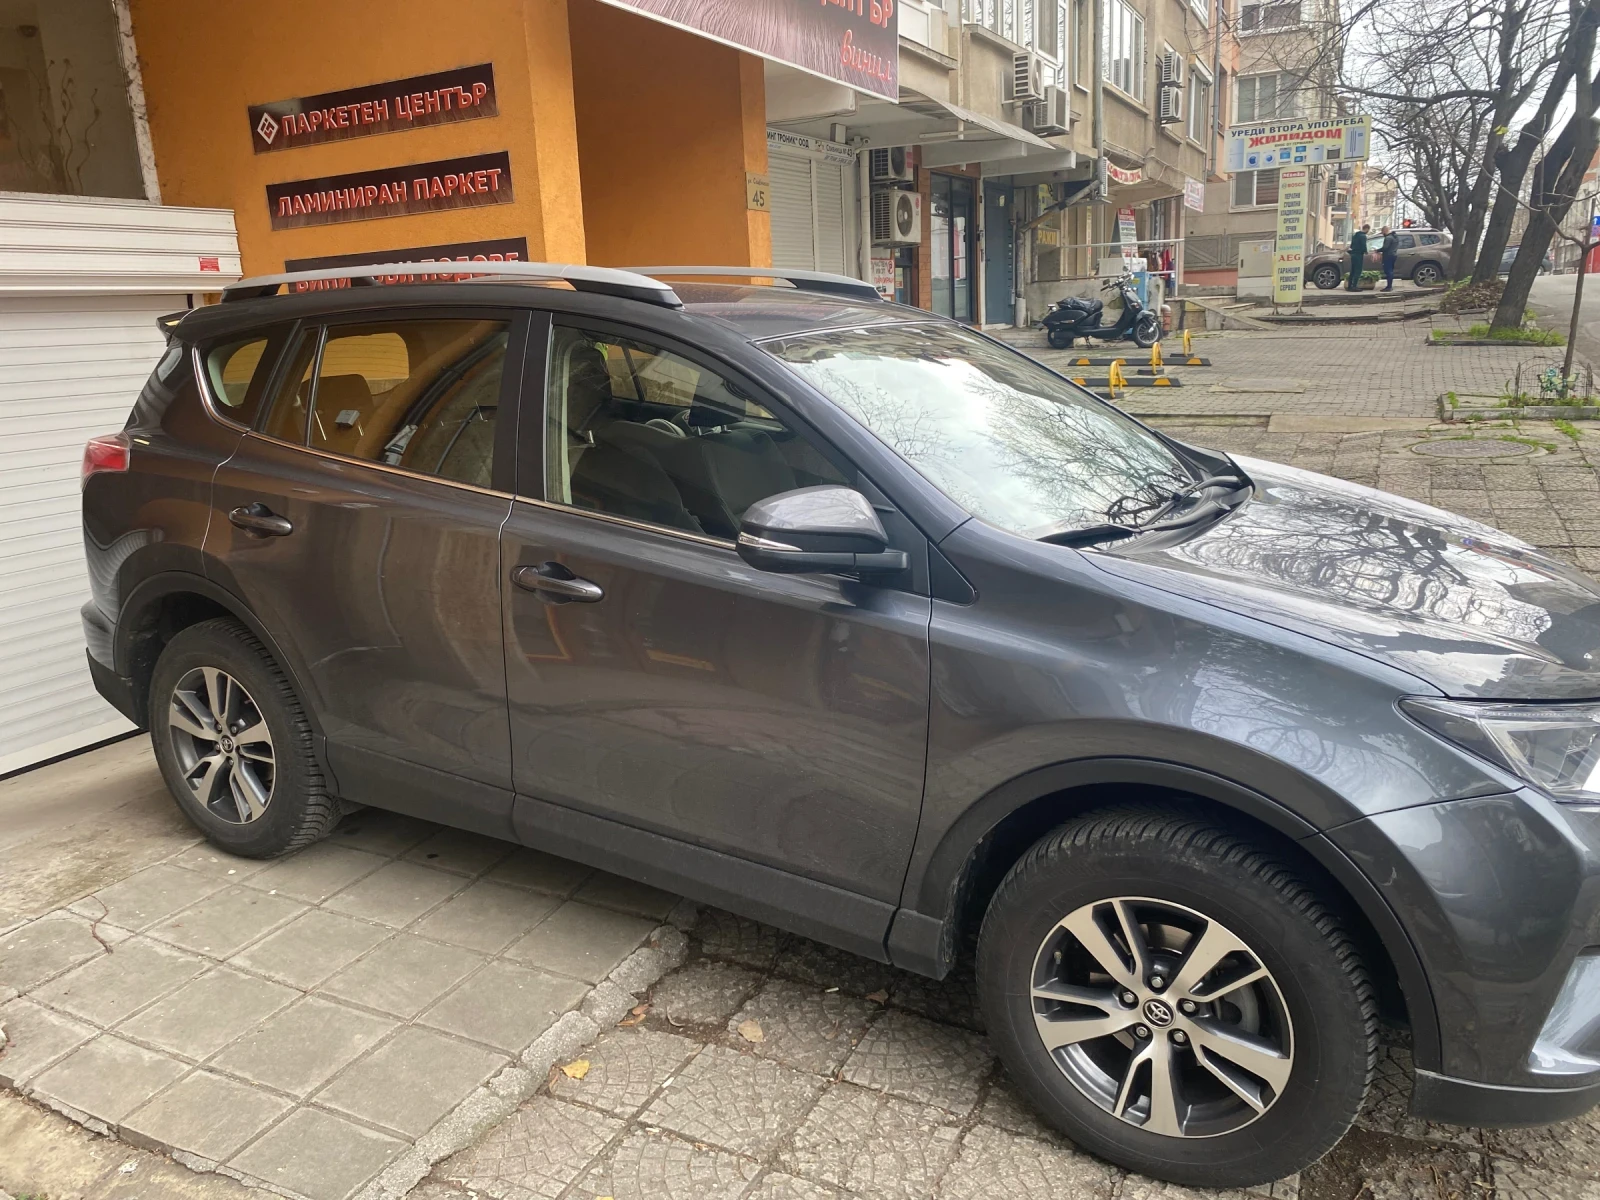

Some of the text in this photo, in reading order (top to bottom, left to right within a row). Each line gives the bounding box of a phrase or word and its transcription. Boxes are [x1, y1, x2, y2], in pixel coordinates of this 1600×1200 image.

[281, 82, 488, 137] ПАРКЕТЕН ЦЕНТЪР
[1231, 117, 1365, 138] УРЕДИ ВТОРА УПОТРЕБА
[1248, 128, 1342, 148] ЖИЛИДОМ
[277, 168, 502, 218] ЛАМИНИРАН ПАРКЕТ
[752, 190, 765, 208] 45
[1278, 253, 1301, 262] AEG
[1279, 275, 1298, 283] РЕМОНТ
